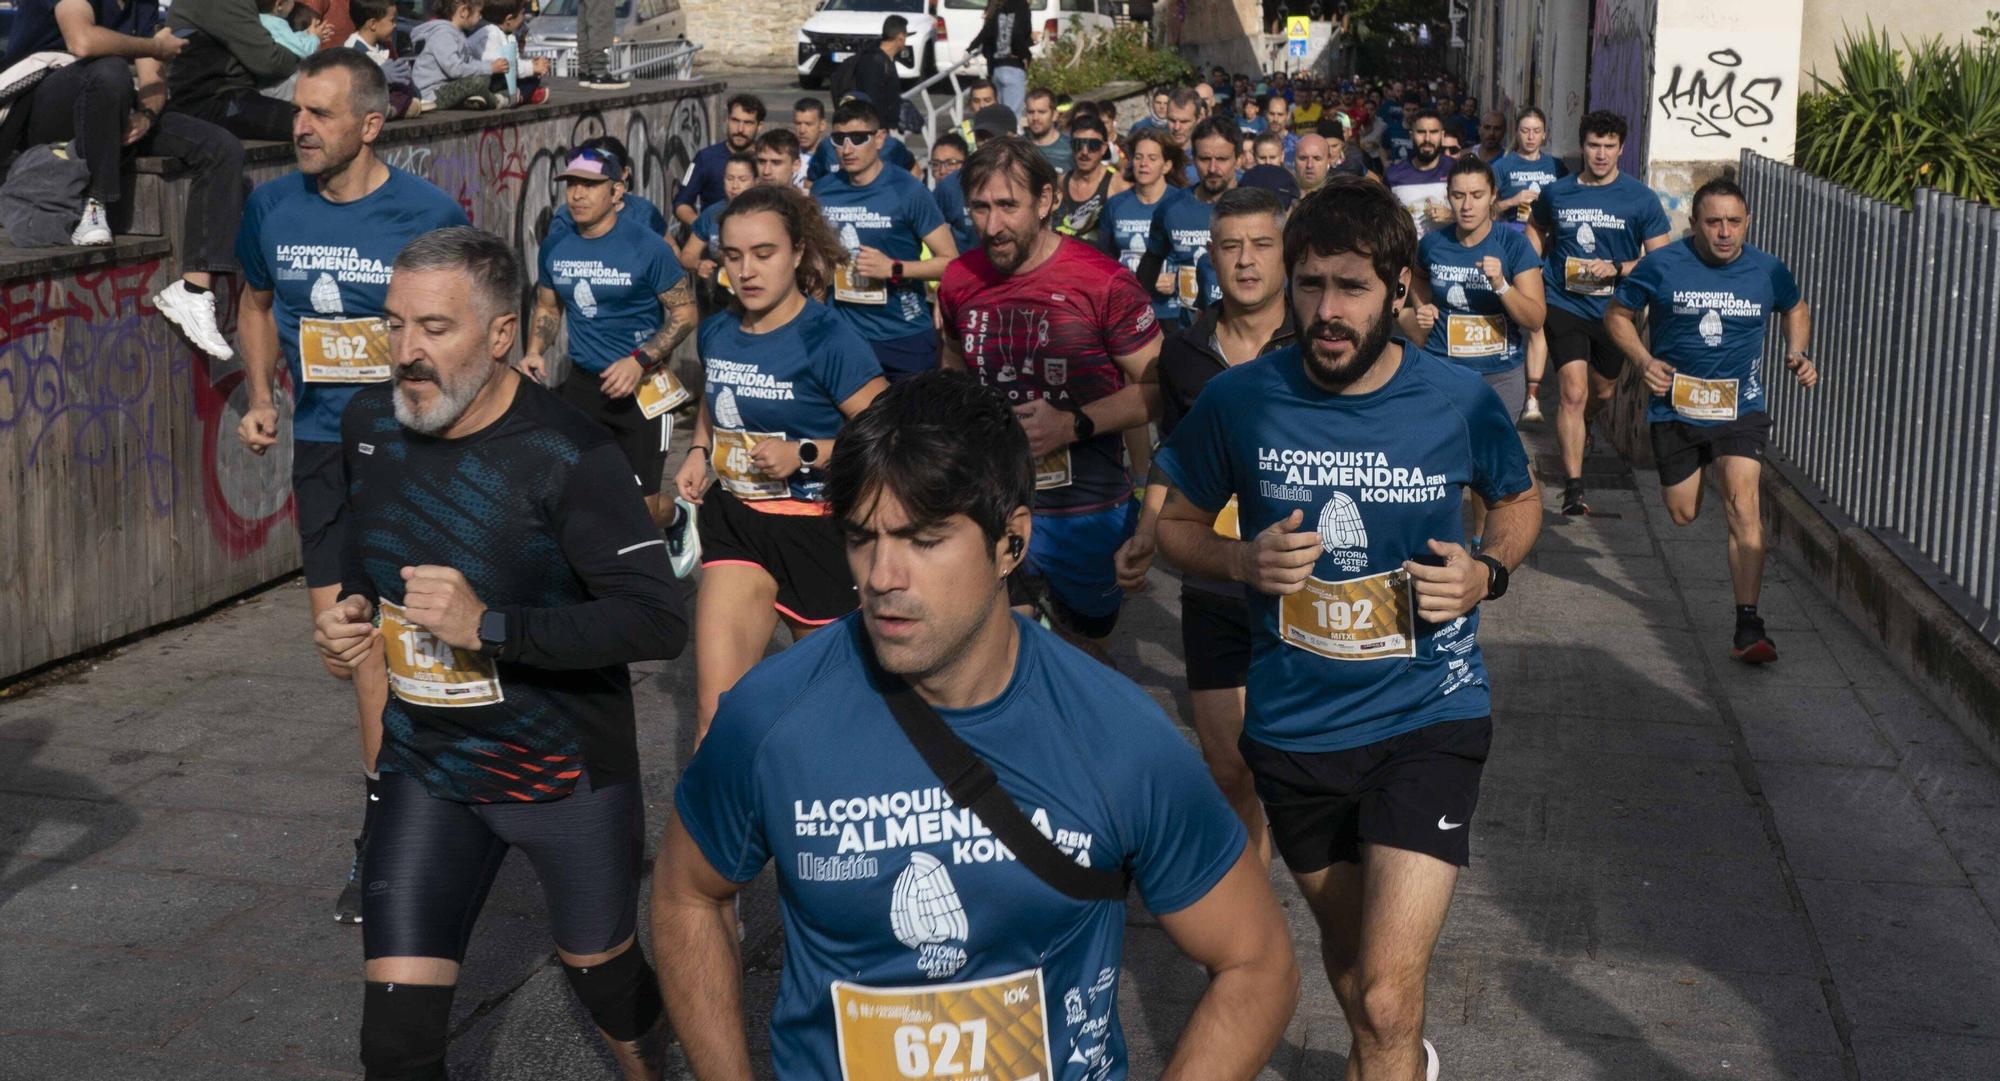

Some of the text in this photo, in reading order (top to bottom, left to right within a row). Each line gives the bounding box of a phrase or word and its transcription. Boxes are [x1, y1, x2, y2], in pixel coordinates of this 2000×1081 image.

[1566, 213, 1616, 223] ALMENDRA
[1180, 229, 1211, 238] CONQUIS
[276, 244, 359, 258] LA CONQUISTA
[291, 256, 384, 274] ALMENDRA
[560, 259, 603, 269] CONQUISTA
[337, 271, 393, 285] KONKIST
[561, 267, 619, 279] ALMENDRA
[1437, 271, 1490, 285] ALMENDR
[1673, 290, 1735, 301] LA CONQUISTA
[1686, 298, 1752, 309] ALMENDRA
[1721, 307, 1762, 317] KONKISTA
[1464, 324, 1492, 342] 231
[321, 334, 369, 360] 562
[707, 368, 776, 389] ALMENDRA
[736, 386, 795, 400] KONKISTA
[1007, 390, 1070, 400] OERA
[1689, 388, 1721, 405] 436
[1258, 447, 1389, 468] LA CONQUISTA
[1259, 461, 1447, 488] DE LA ALMENDRA REN
[1270, 483, 1313, 502] Edición
[1360, 484, 1446, 503] KONKISTA
[1332, 550, 1368, 559] VITORIA
[1333, 557, 1368, 568] GASTEIZ
[1341, 565, 1361, 573] 2025
[1312, 598, 1374, 631] 192
[1330, 631, 1358, 641] MITXE
[794, 787, 954, 823] LA CONQUIS
[796, 806, 1093, 855] DE LA ALMENA REN
[813, 852, 879, 882] Edición
[1003, 984, 1030, 1007] 10K
[893, 1017, 988, 1079] 627
